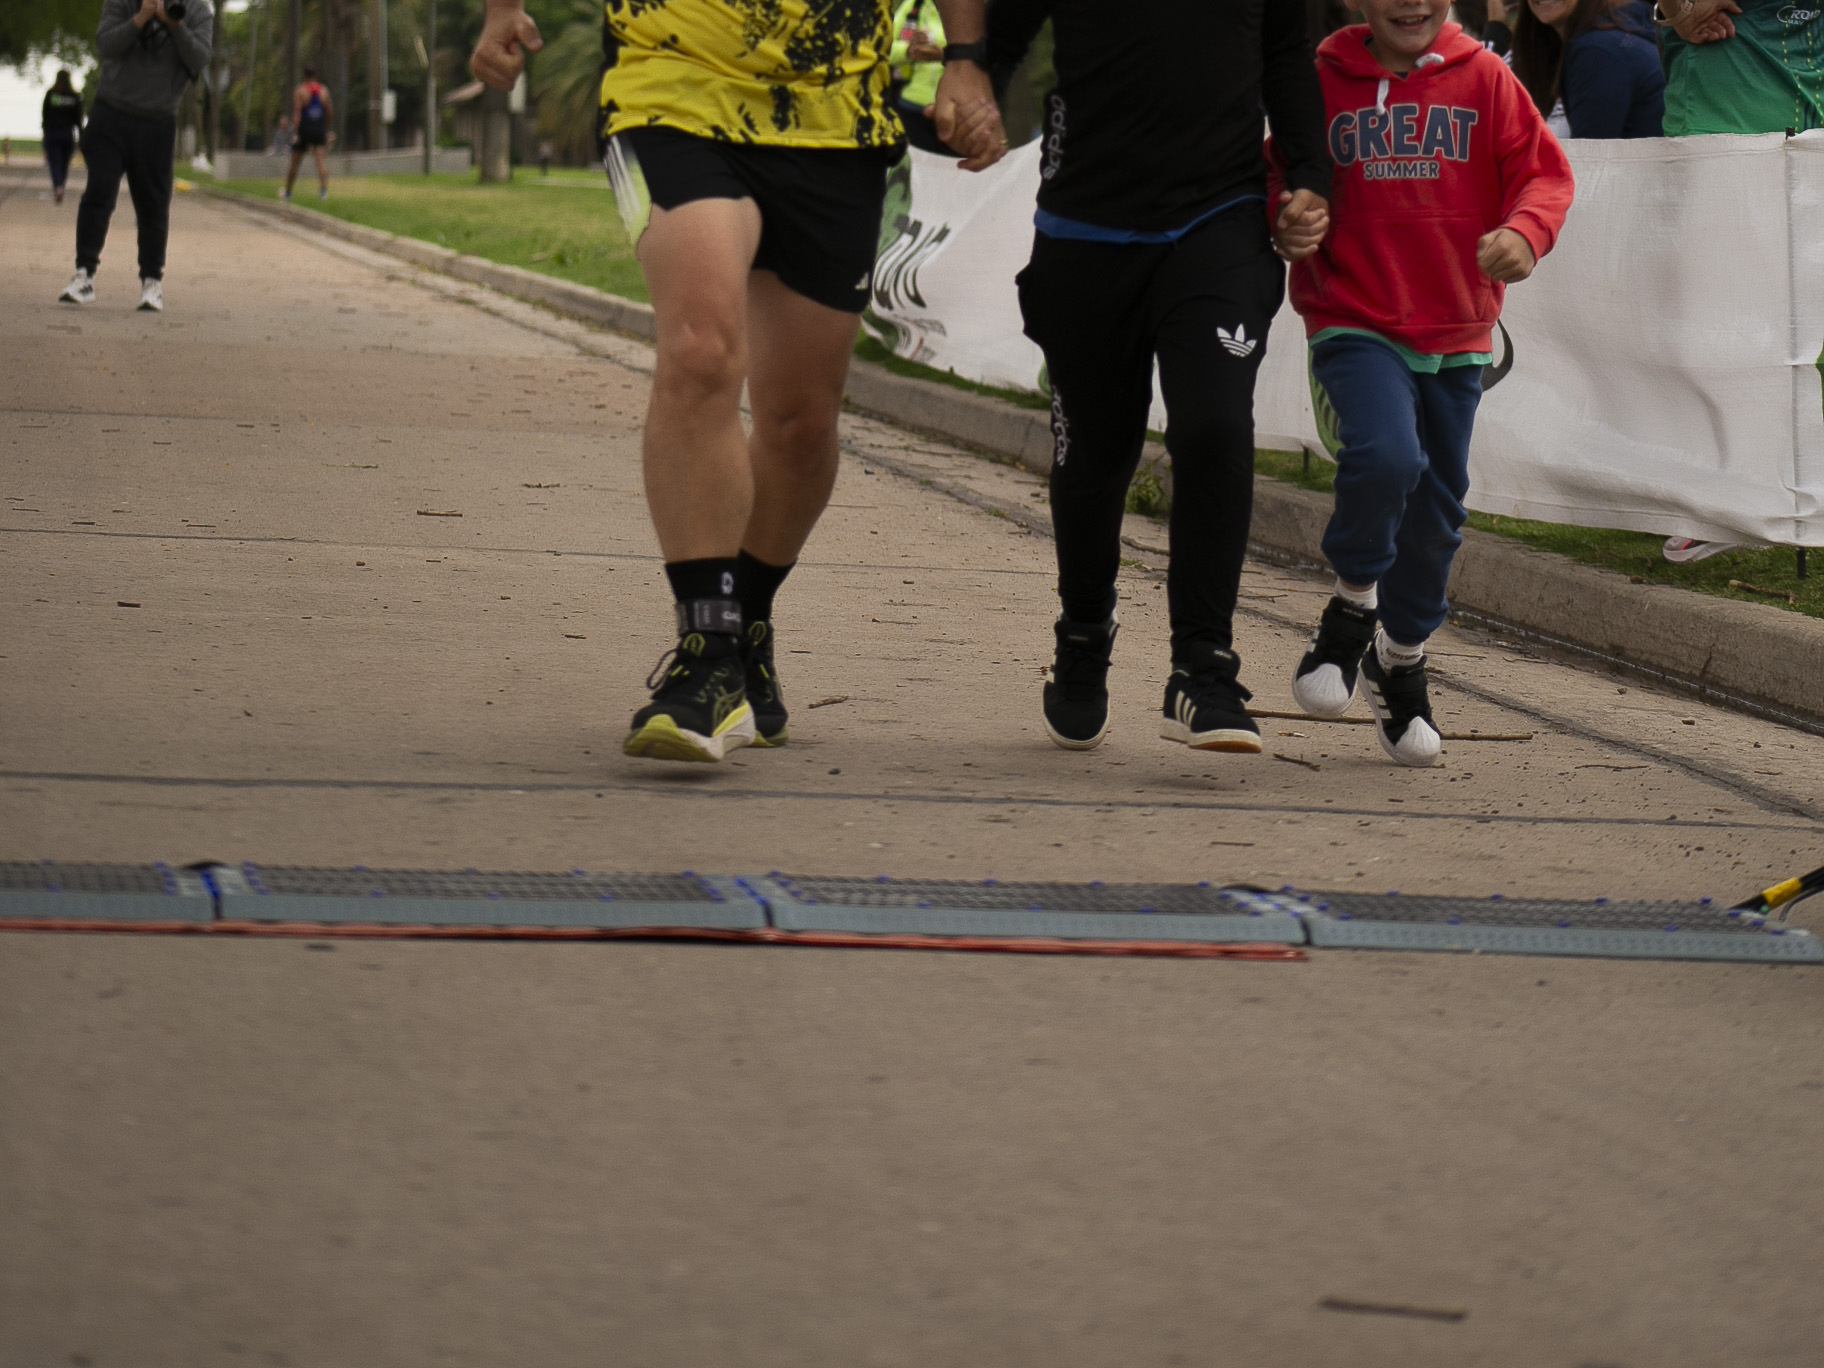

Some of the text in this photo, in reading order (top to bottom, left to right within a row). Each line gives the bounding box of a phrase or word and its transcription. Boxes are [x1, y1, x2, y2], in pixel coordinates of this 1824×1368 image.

[1043, 95, 1067, 180] adidas
[1328, 103, 1478, 167] GREAT
[1363, 160, 1440, 180] SUMMER
